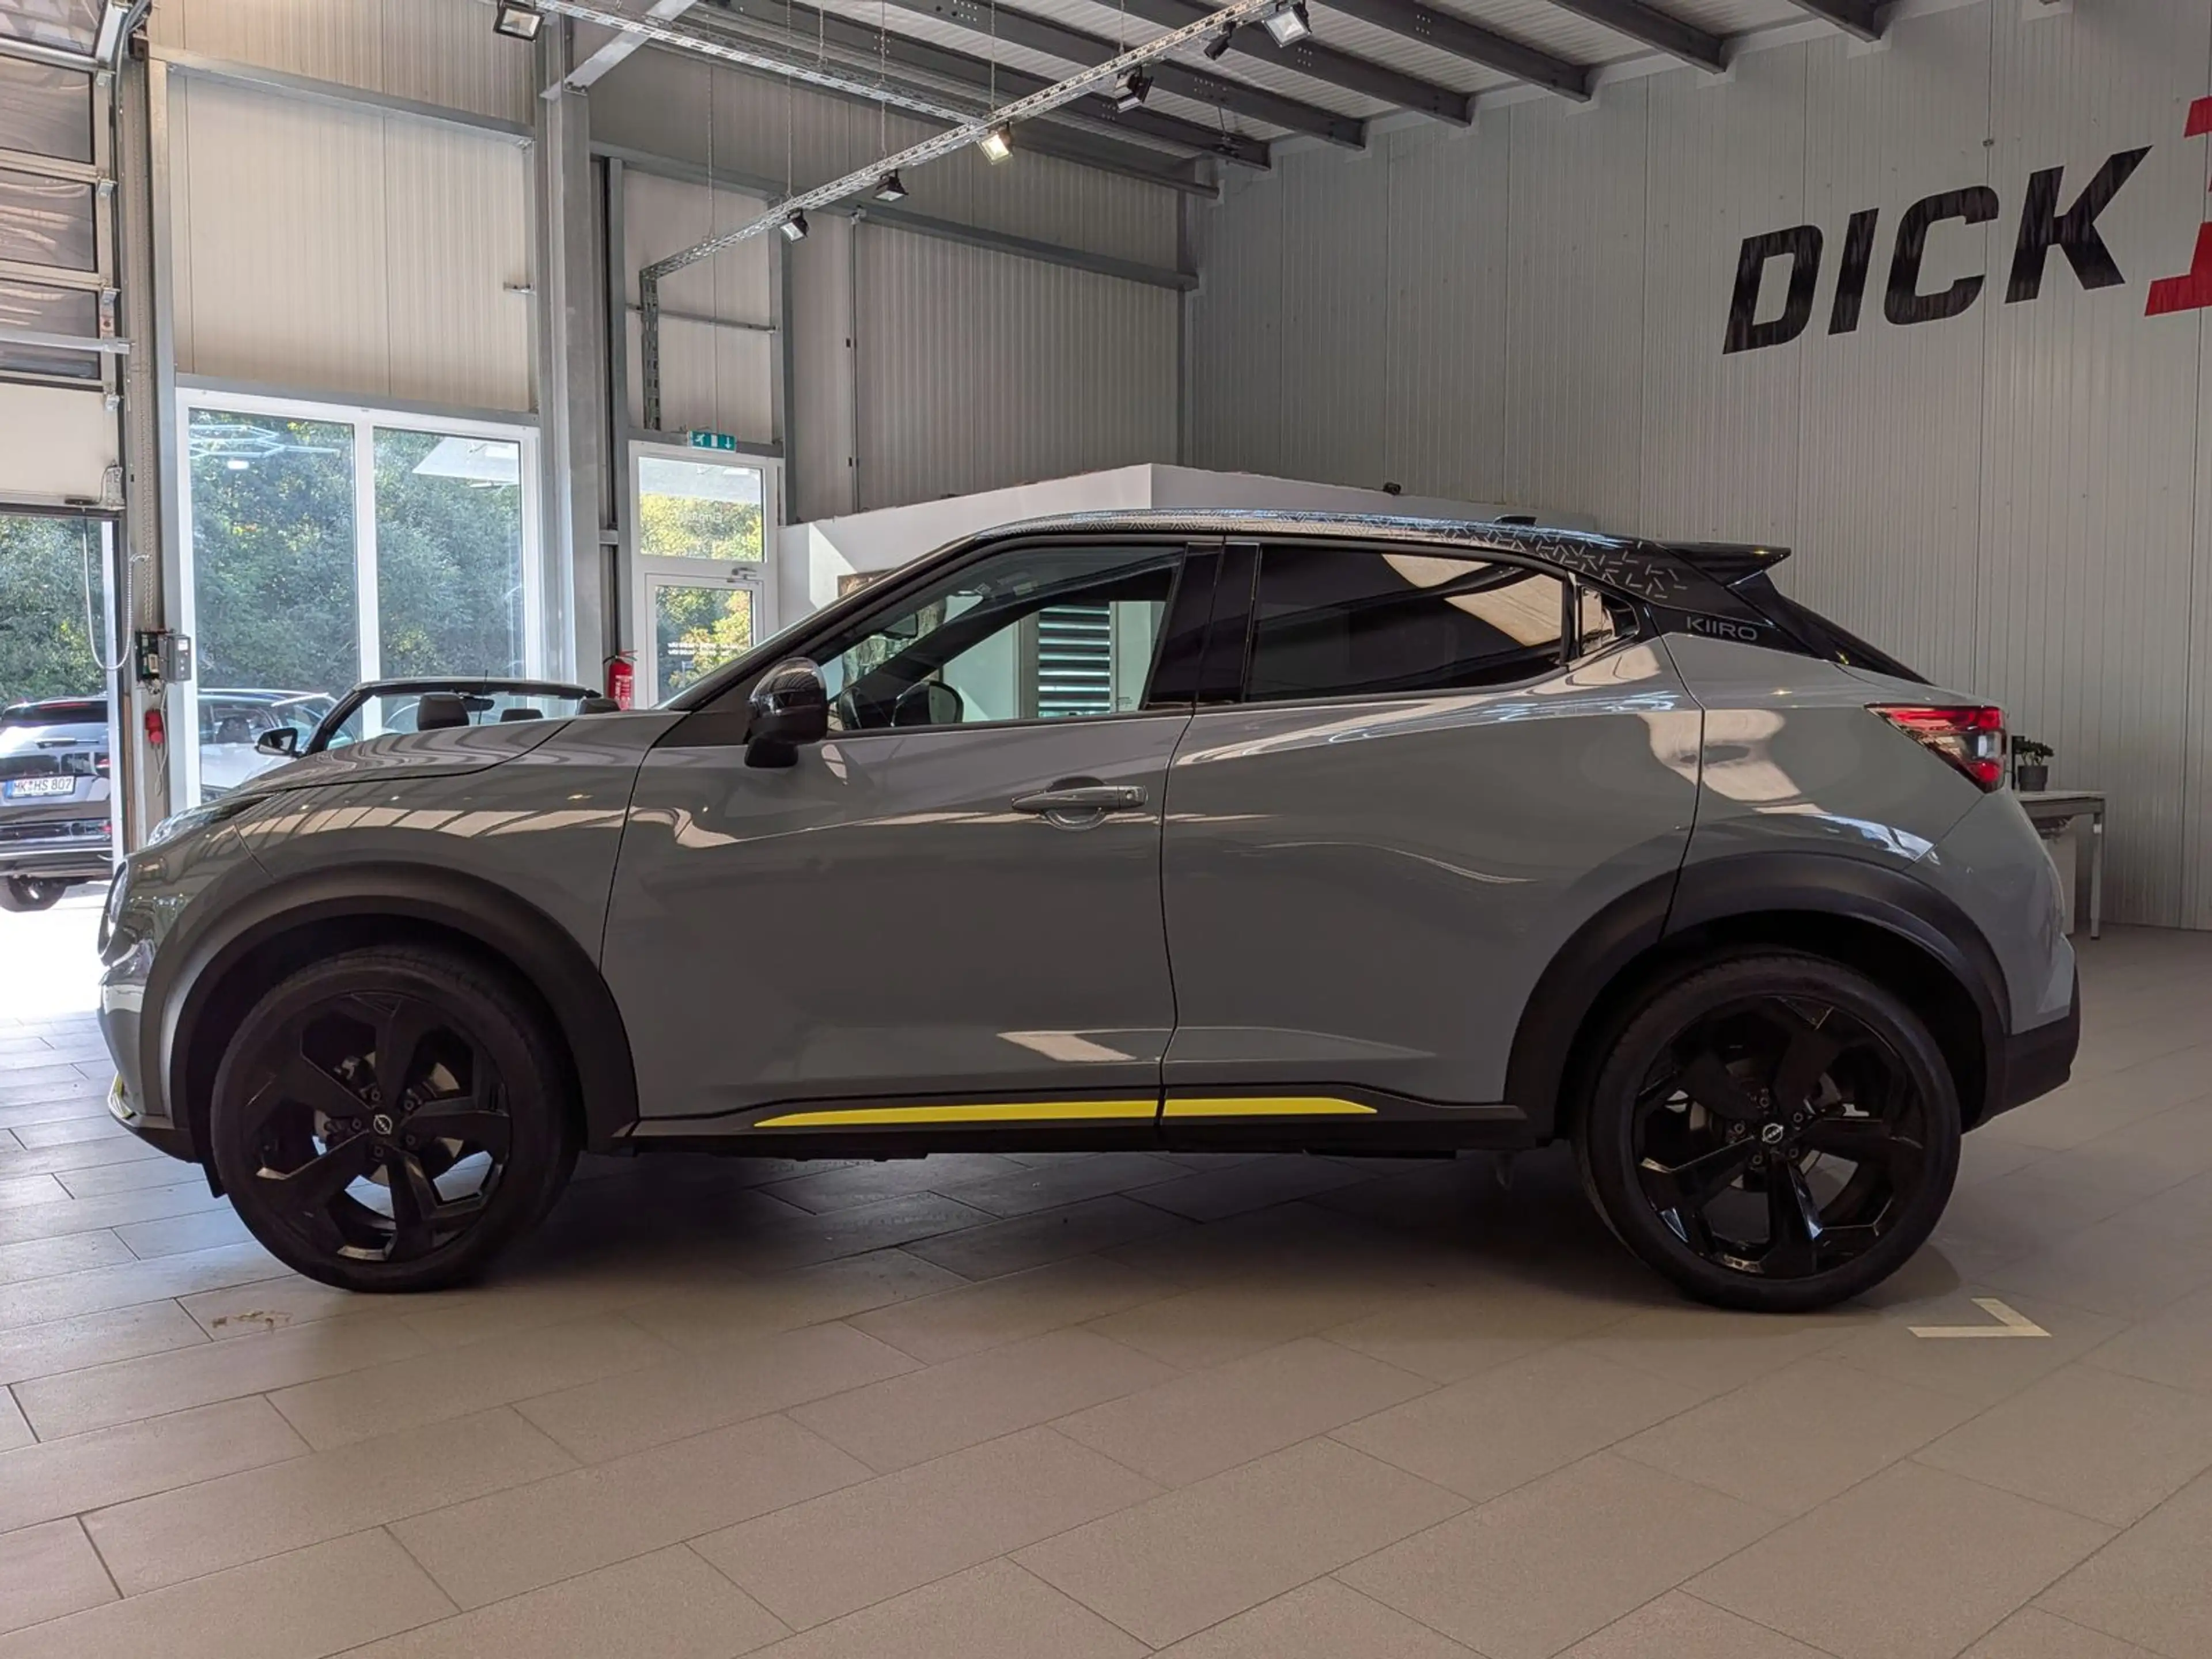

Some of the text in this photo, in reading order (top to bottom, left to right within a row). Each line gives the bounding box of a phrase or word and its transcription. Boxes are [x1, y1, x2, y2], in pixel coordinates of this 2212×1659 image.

[1722, 145, 2153, 354] DICK
[1687, 616, 1758, 641] KIIRO
[51, 778, 71, 790] 807
